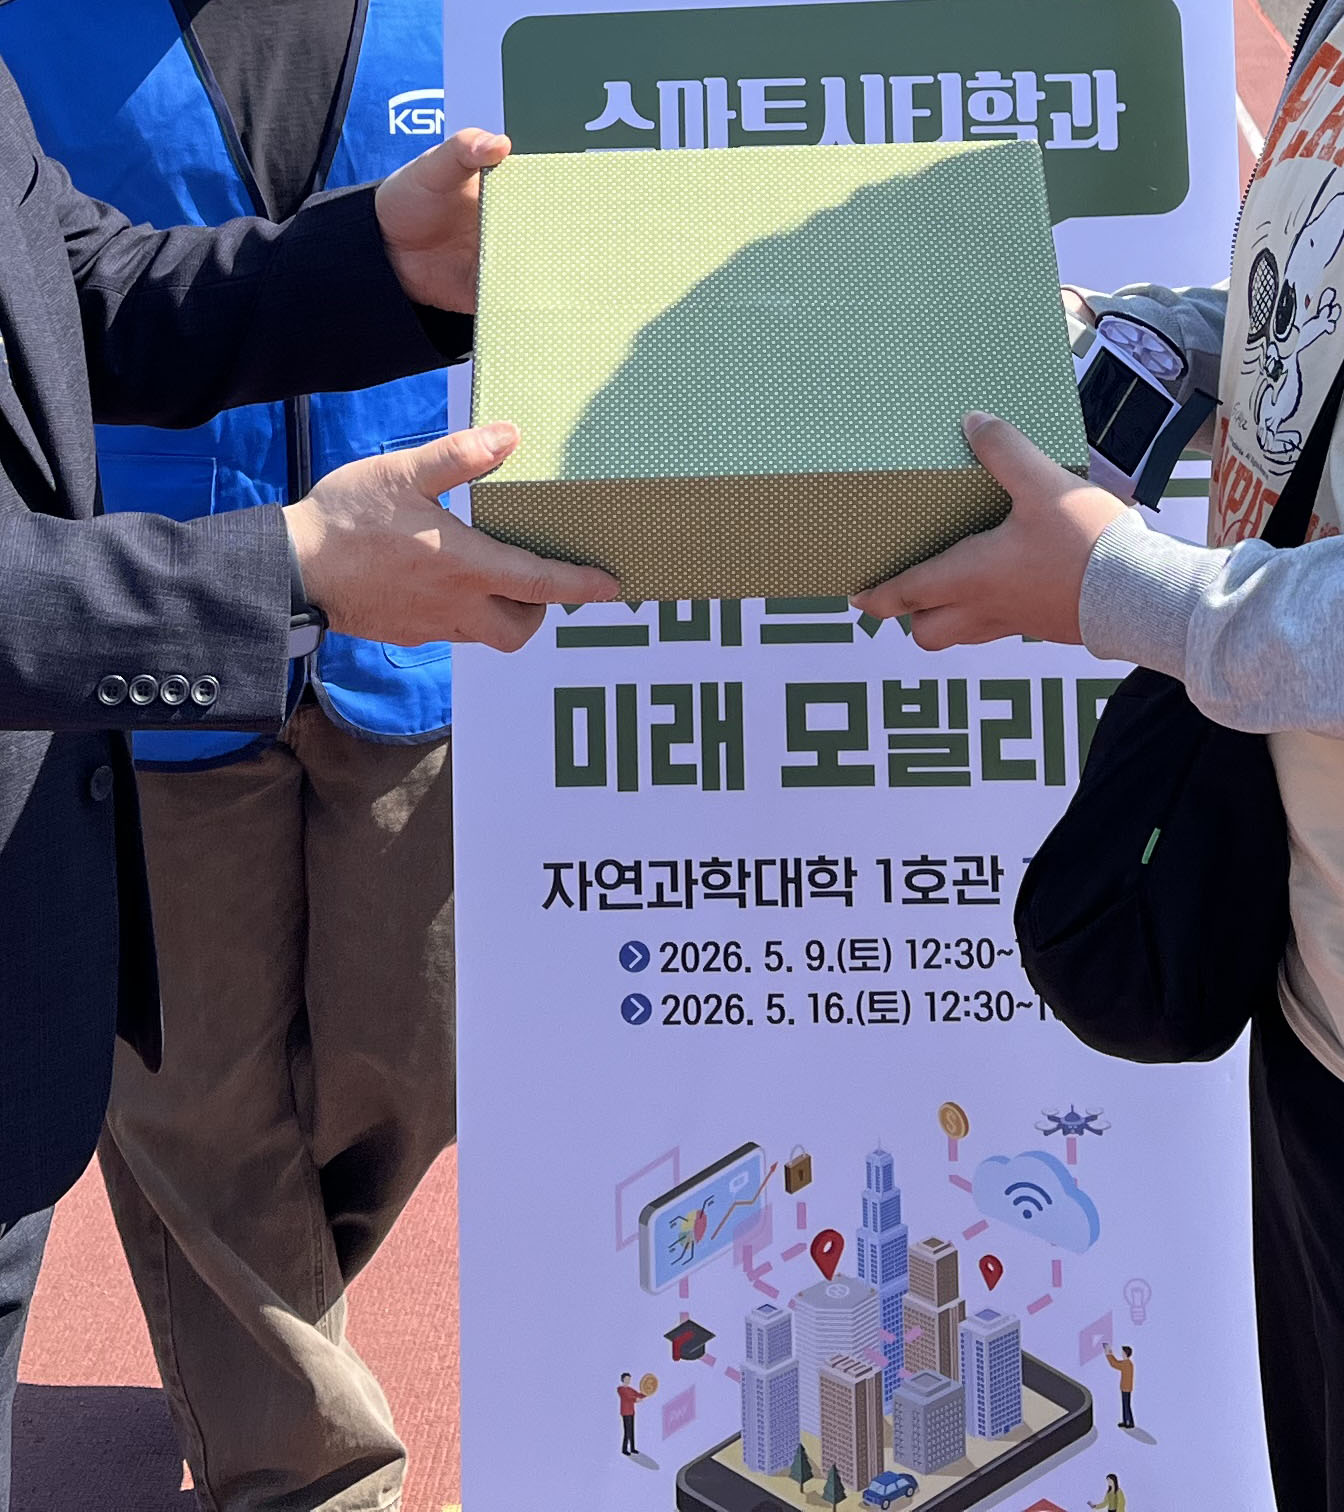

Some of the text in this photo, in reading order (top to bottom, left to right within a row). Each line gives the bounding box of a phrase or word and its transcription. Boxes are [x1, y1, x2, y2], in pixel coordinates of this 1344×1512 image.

[584, 69, 1126, 152] 스마트시티학과
[553, 681, 745, 792] 미래
[540, 854, 1005, 912] 자연과학대학 1호관
[659, 940, 752, 974] 2026.
[764, 940, 793, 973] 5.
[905, 937, 1024, 970] 12:30~
[661, 993, 754, 1026] 2026.
[766, 993, 795, 1026] 5.
[924, 990, 1056, 1023] 12:30~1
